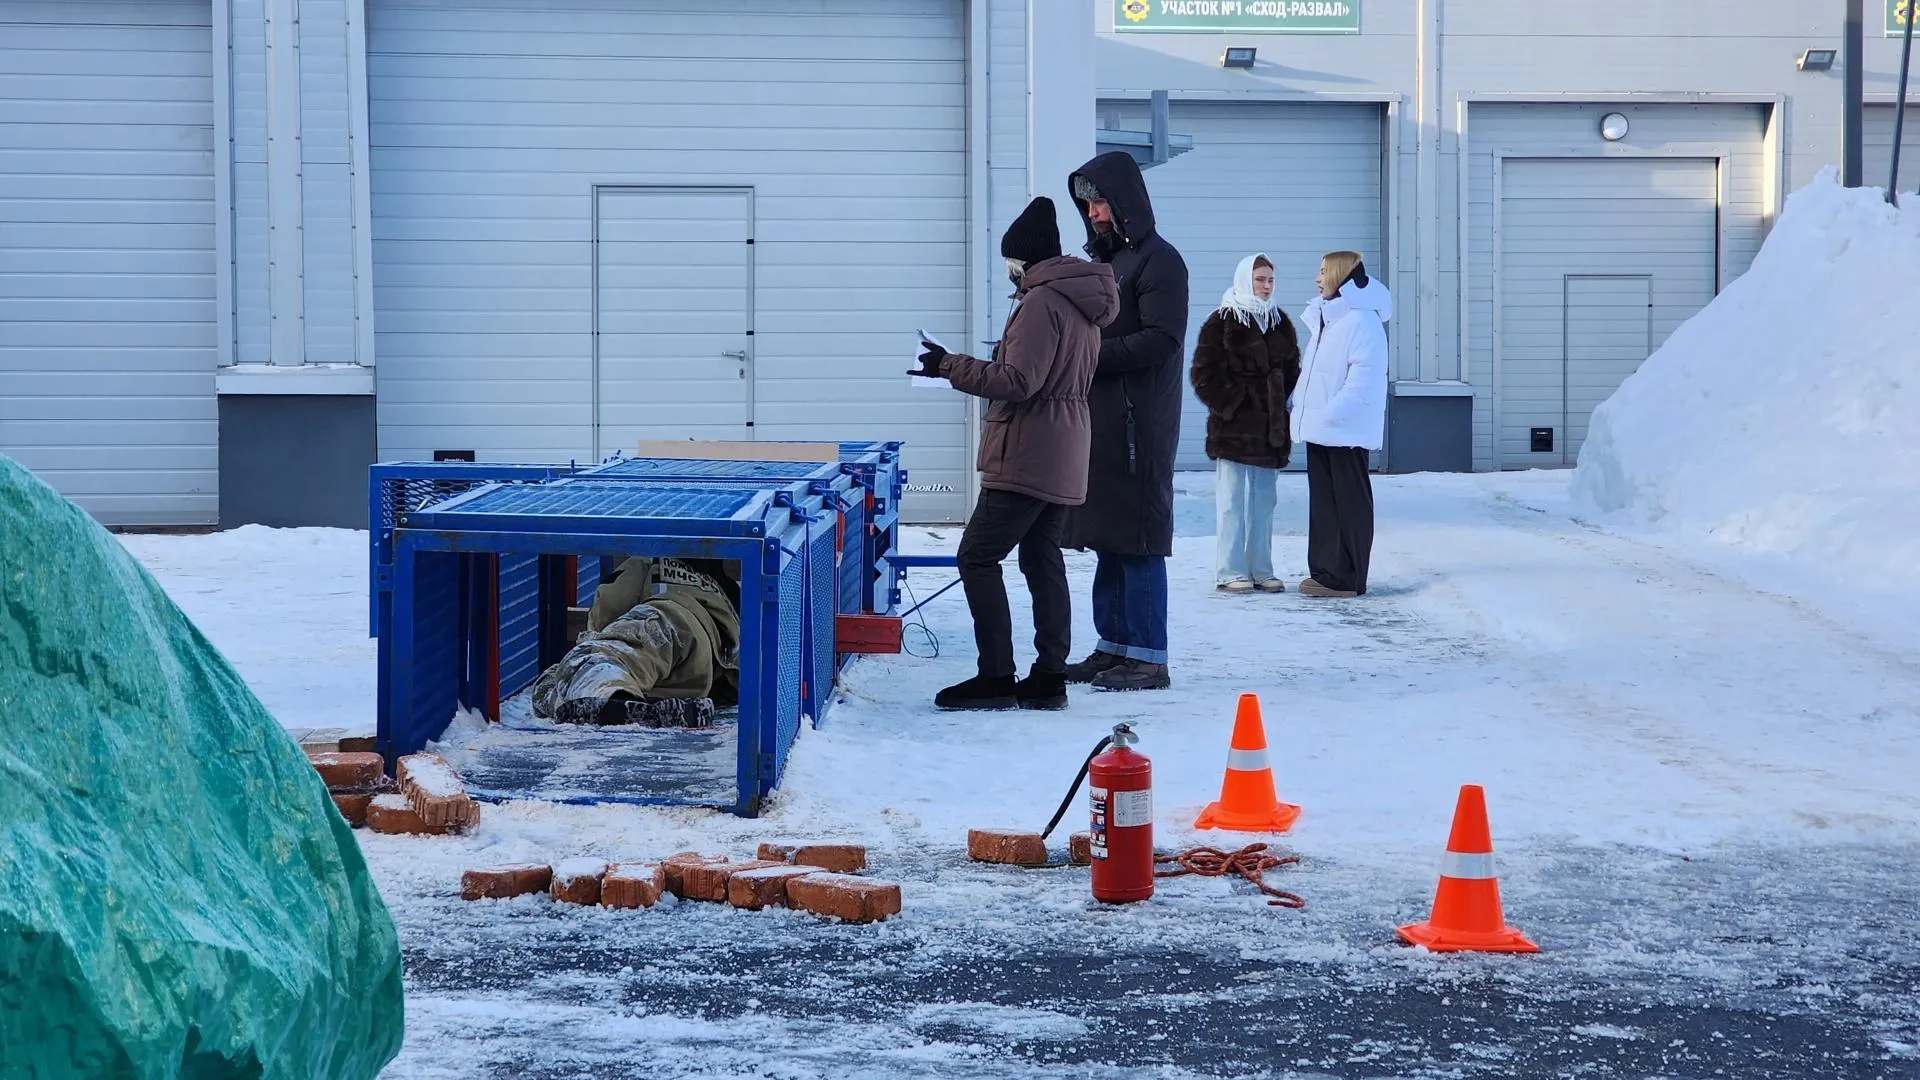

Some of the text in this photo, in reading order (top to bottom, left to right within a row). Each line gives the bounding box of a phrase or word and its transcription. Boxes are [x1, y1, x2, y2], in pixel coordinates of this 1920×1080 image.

[1160, 0, 1219, 16] УЧАСТОК
[1221, 0, 1242, 16] №1
[1245, 1, 1350, 19] «СХОД-РАЗВАЛ»
[663, 567, 698, 583] МЧС
